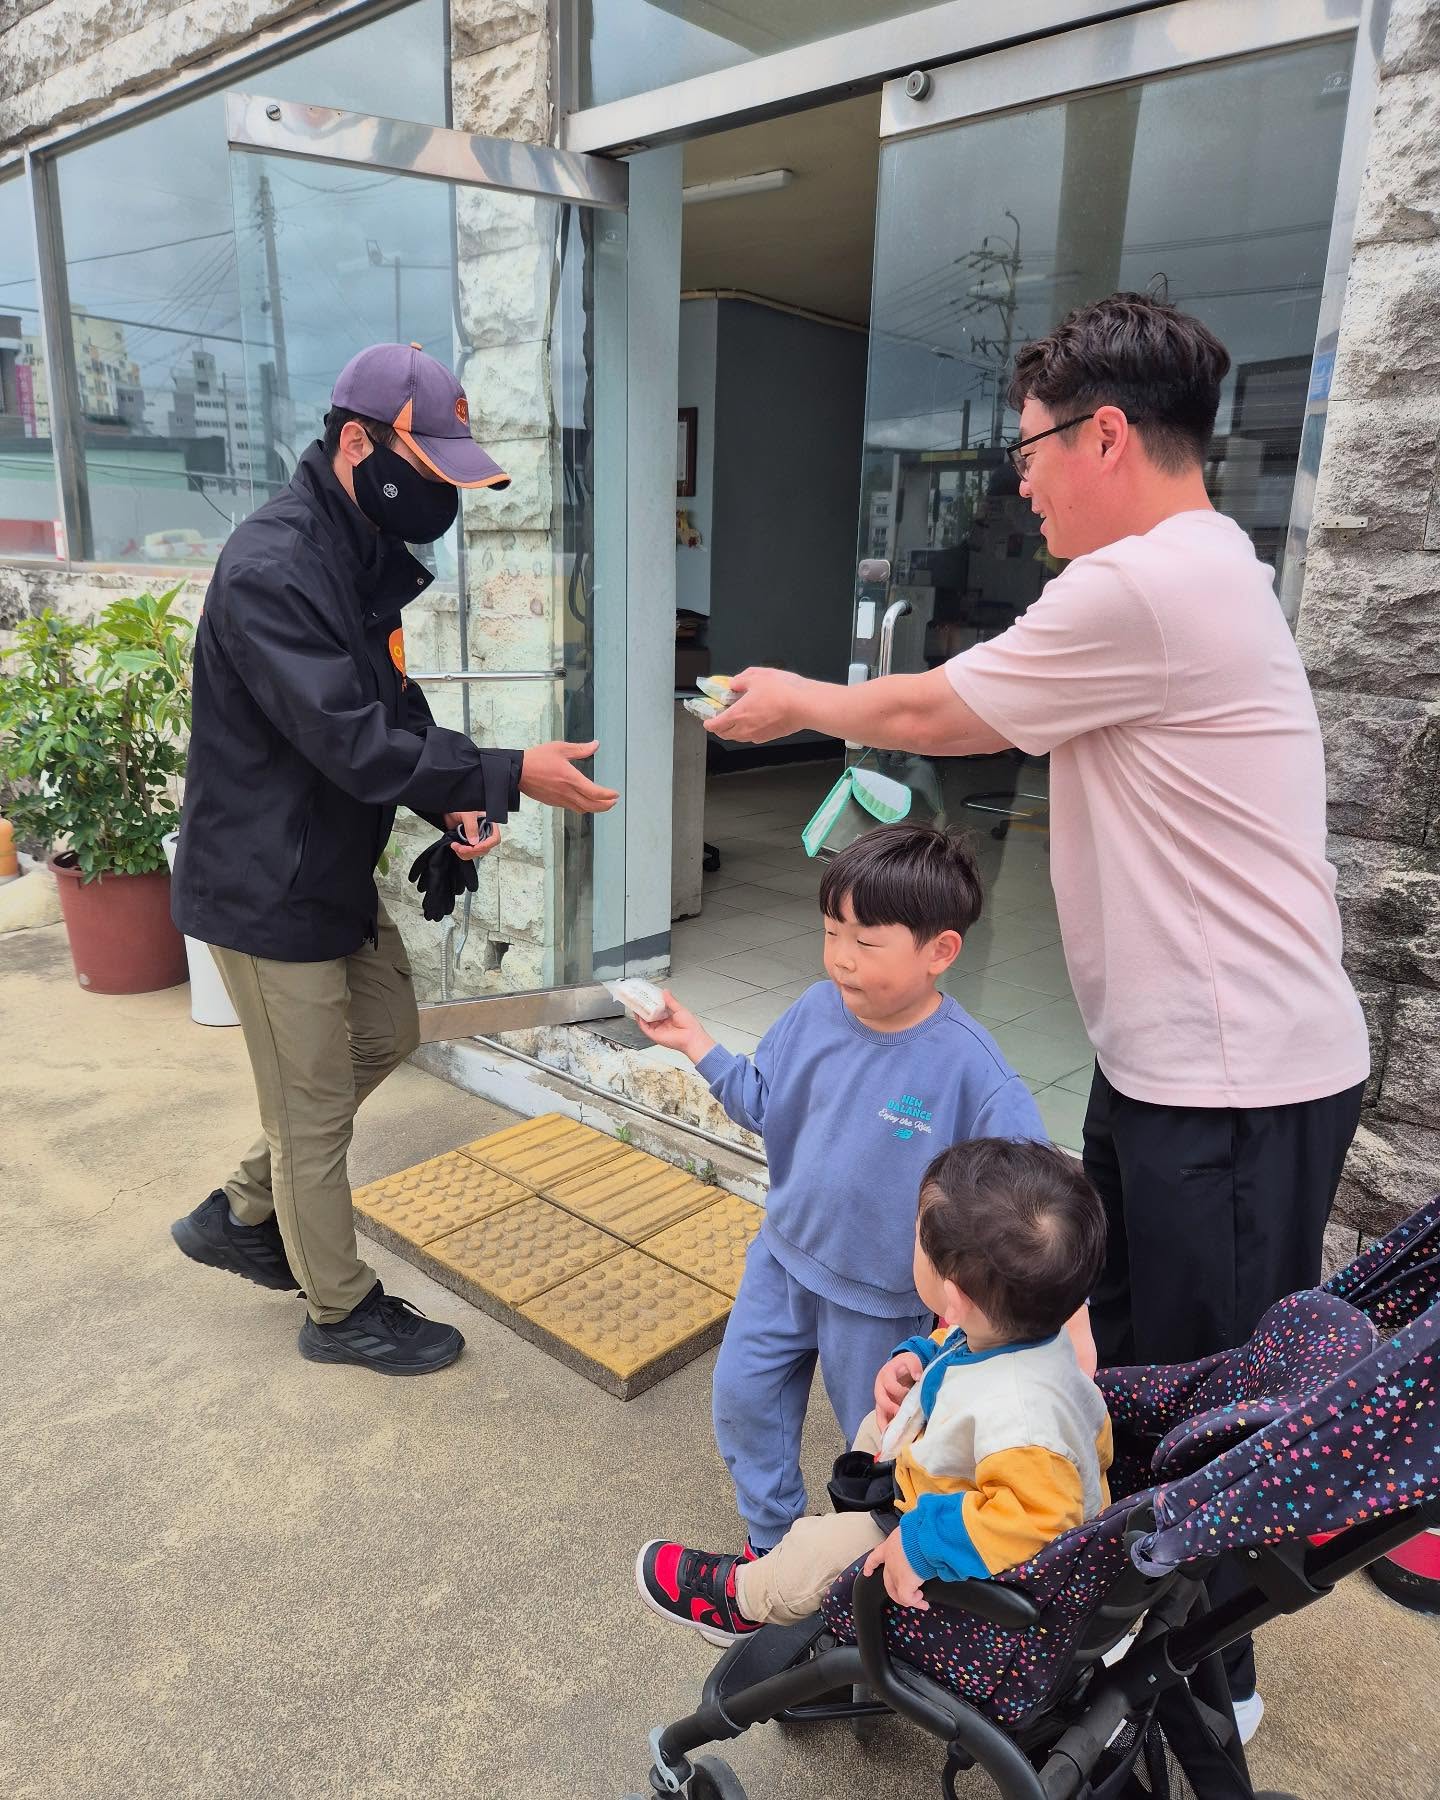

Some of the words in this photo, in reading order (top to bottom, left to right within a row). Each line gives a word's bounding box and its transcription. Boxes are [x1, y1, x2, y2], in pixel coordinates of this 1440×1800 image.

[878, 1108, 899, 1122] Enjoy
[899, 1117, 913, 1127] the
[888, 1099, 931, 1120] BALANCE
